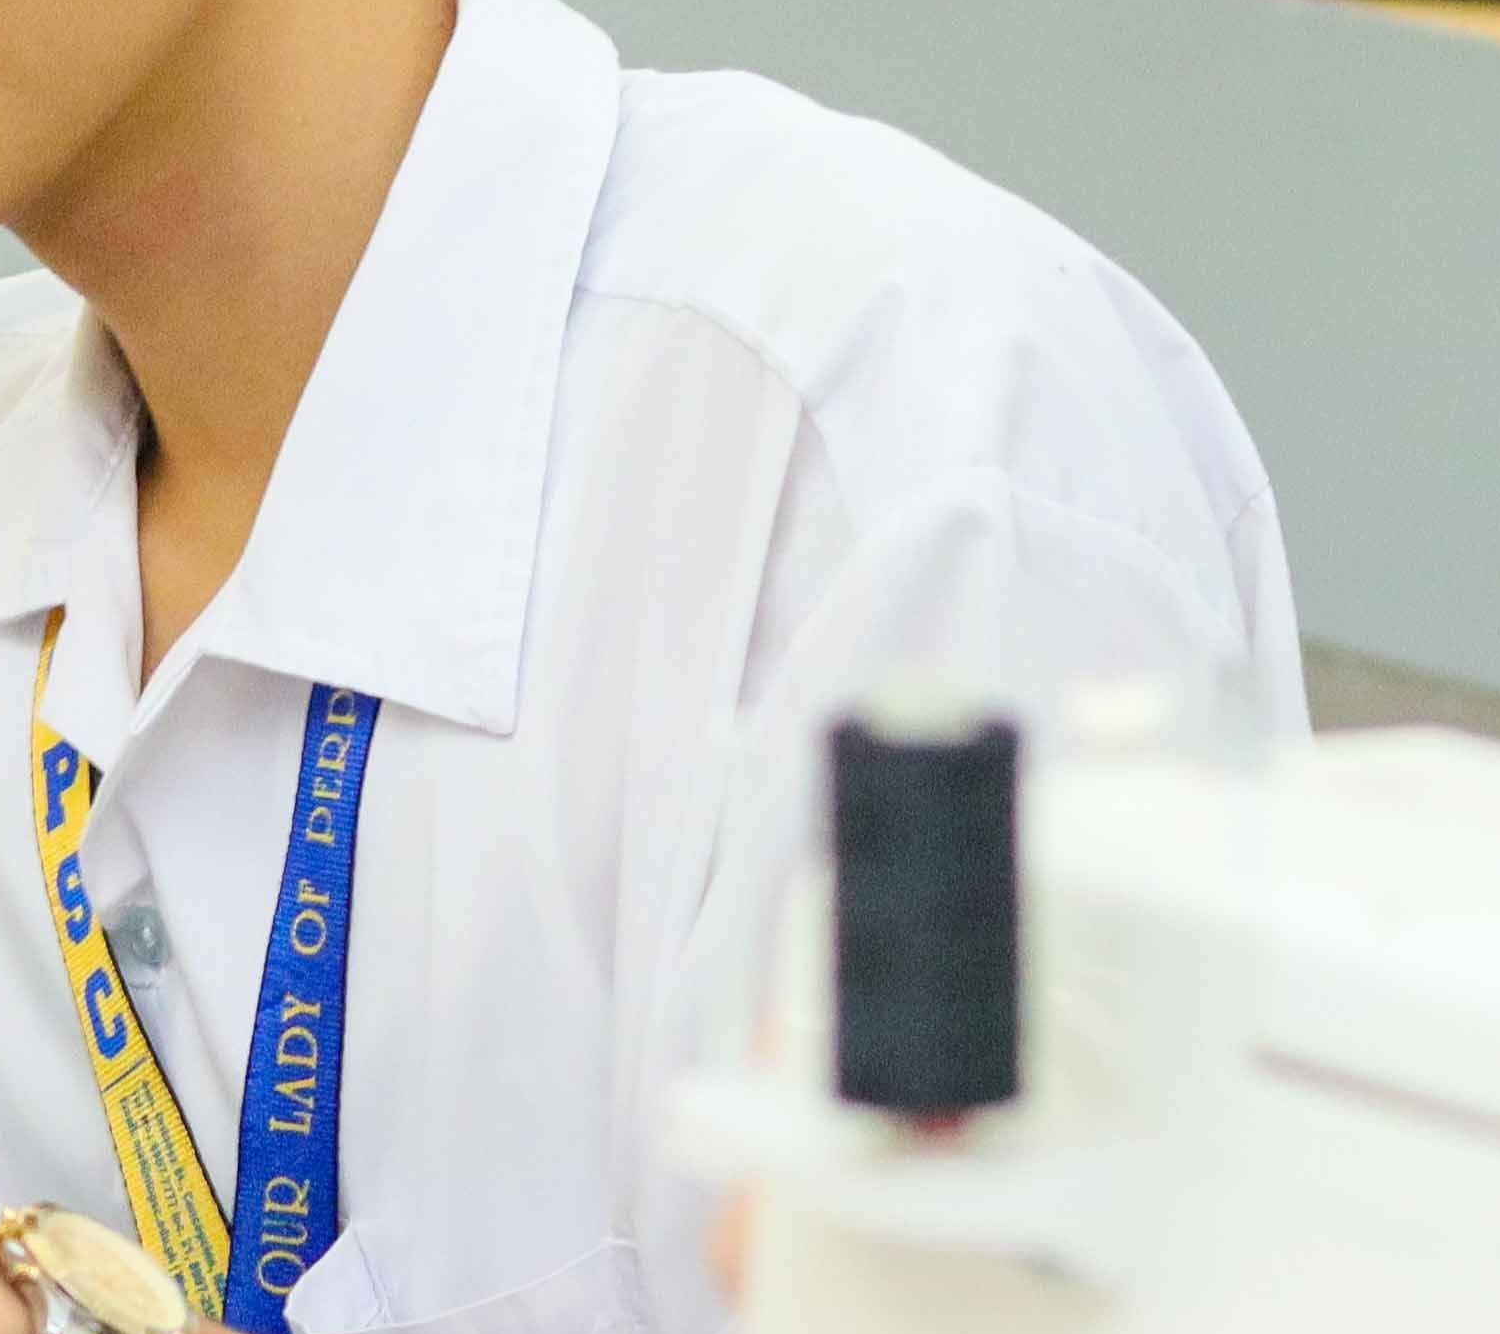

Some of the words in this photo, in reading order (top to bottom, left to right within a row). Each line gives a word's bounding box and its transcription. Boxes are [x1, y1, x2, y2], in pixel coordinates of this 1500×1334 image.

[290, 878, 332, 956] OF
[269, 990, 322, 1136] LADY
[257, 1176, 311, 1295] OUR
